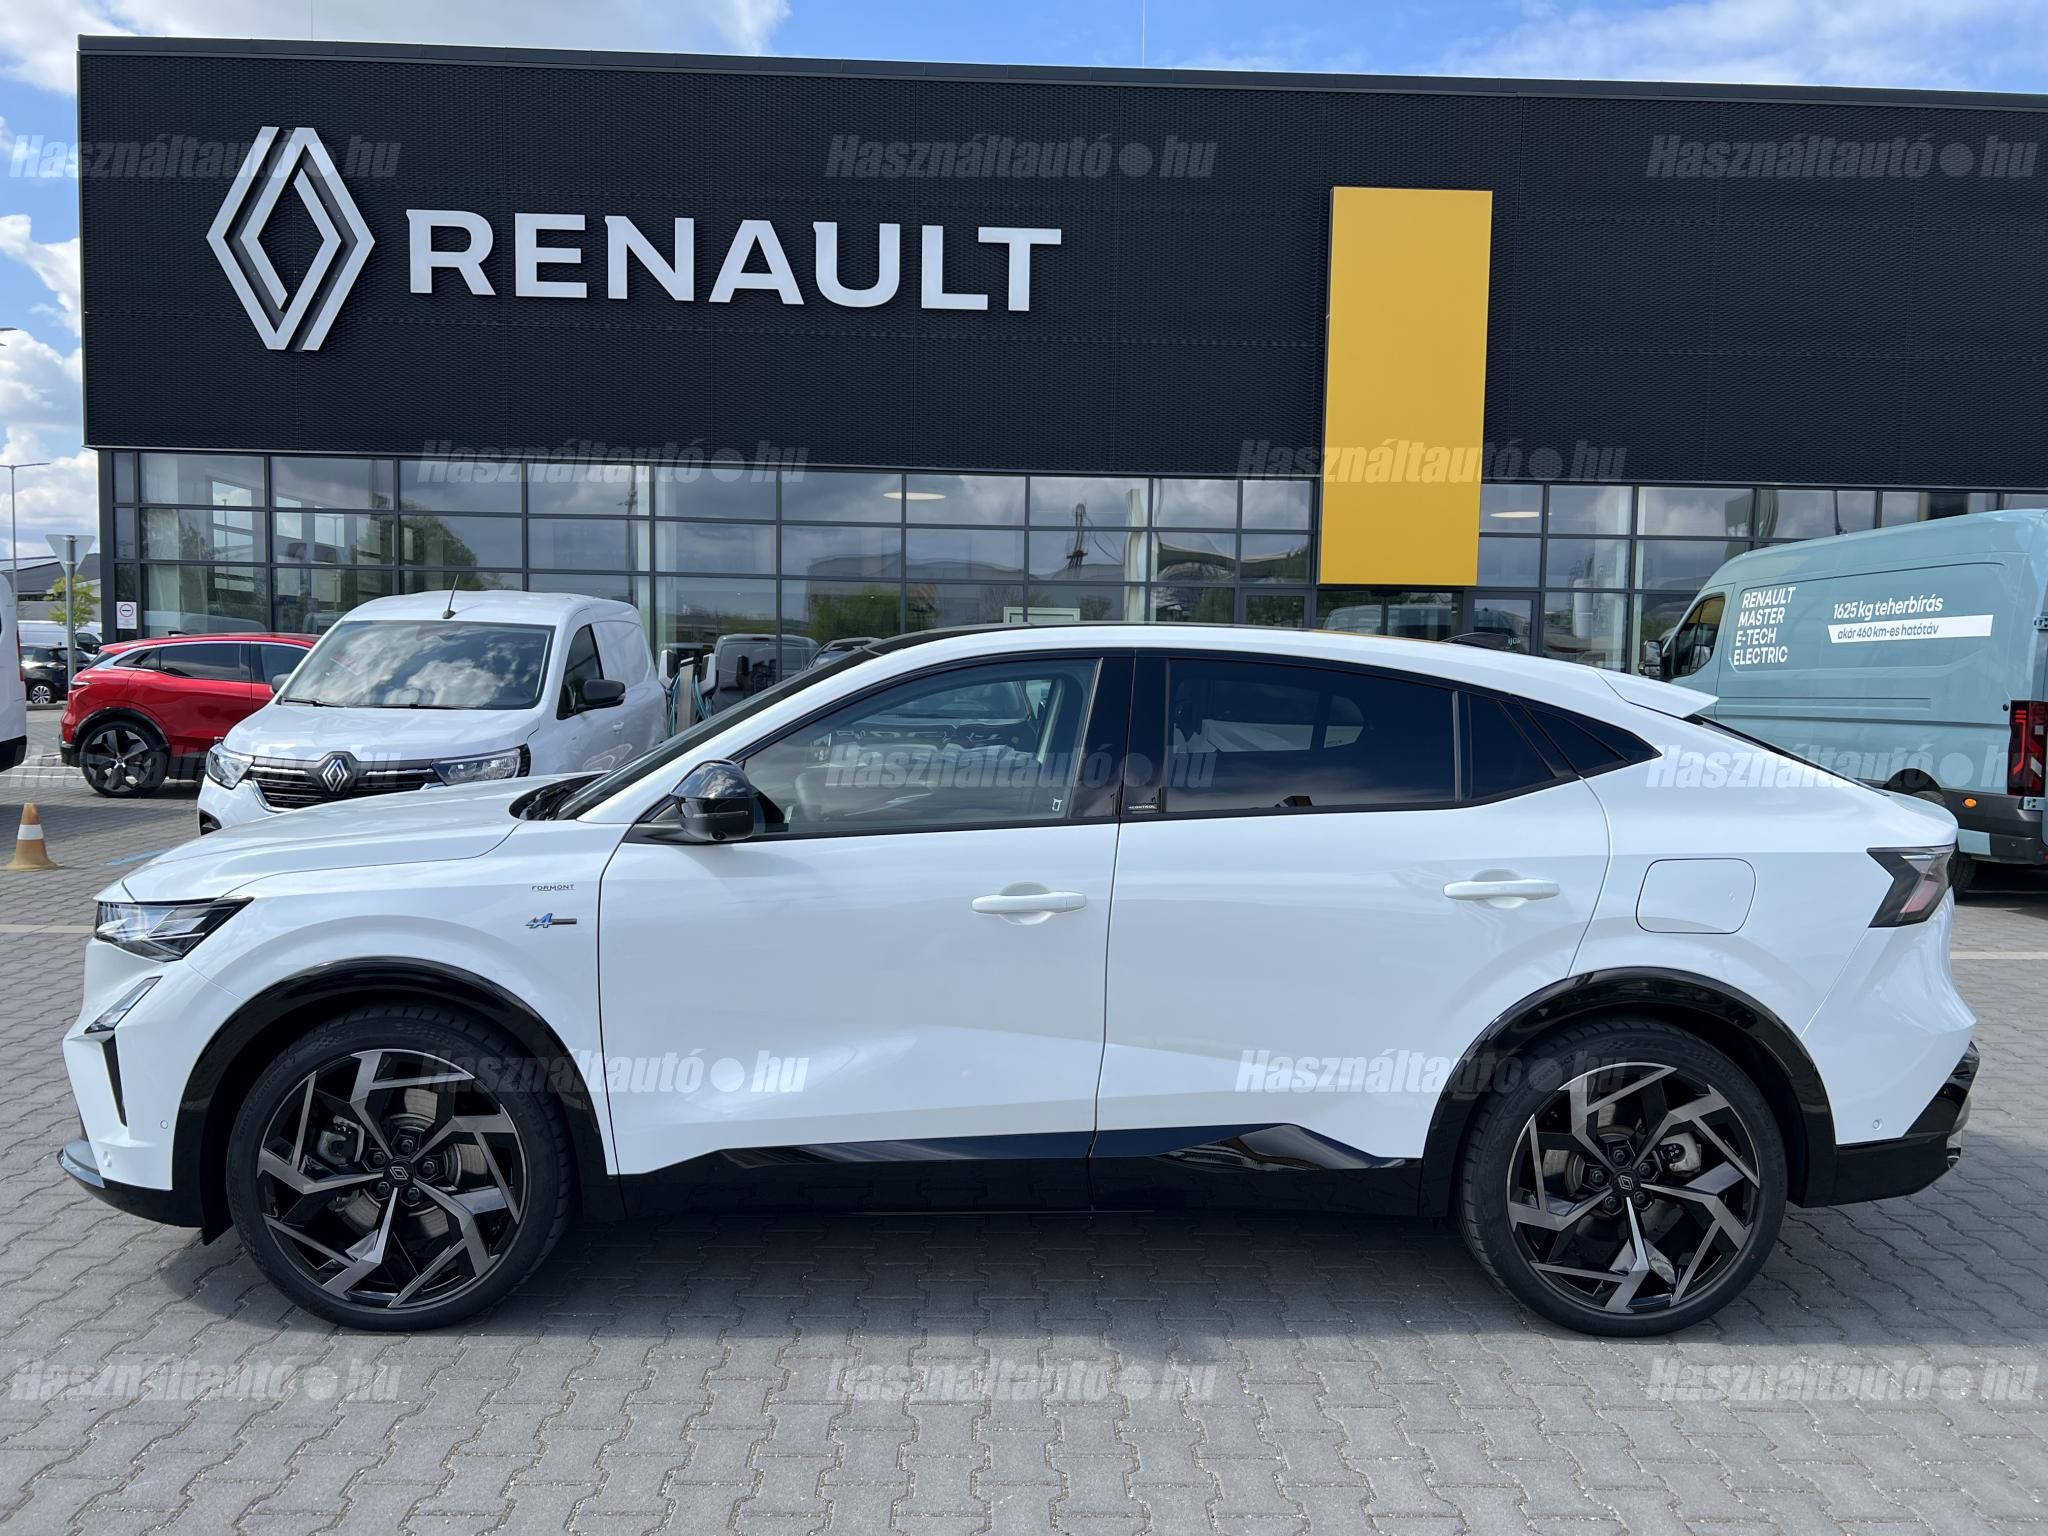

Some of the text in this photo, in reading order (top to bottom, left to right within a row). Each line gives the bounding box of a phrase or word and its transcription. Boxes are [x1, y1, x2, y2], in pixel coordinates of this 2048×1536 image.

[406, 208, 1062, 312] RENAULT
[1742, 586, 1796, 609] RENAULT
[1833, 594, 1944, 621] 1625 kg teherbírás
[1738, 607, 1785, 627] MASTER
[1735, 627, 1777, 647] E-TECH
[1837, 624, 1939, 640] akár 460 km-es hatótáv
[1733, 645, 1788, 665] ELECTRIC
[531, 884, 576, 892] FORMONT
